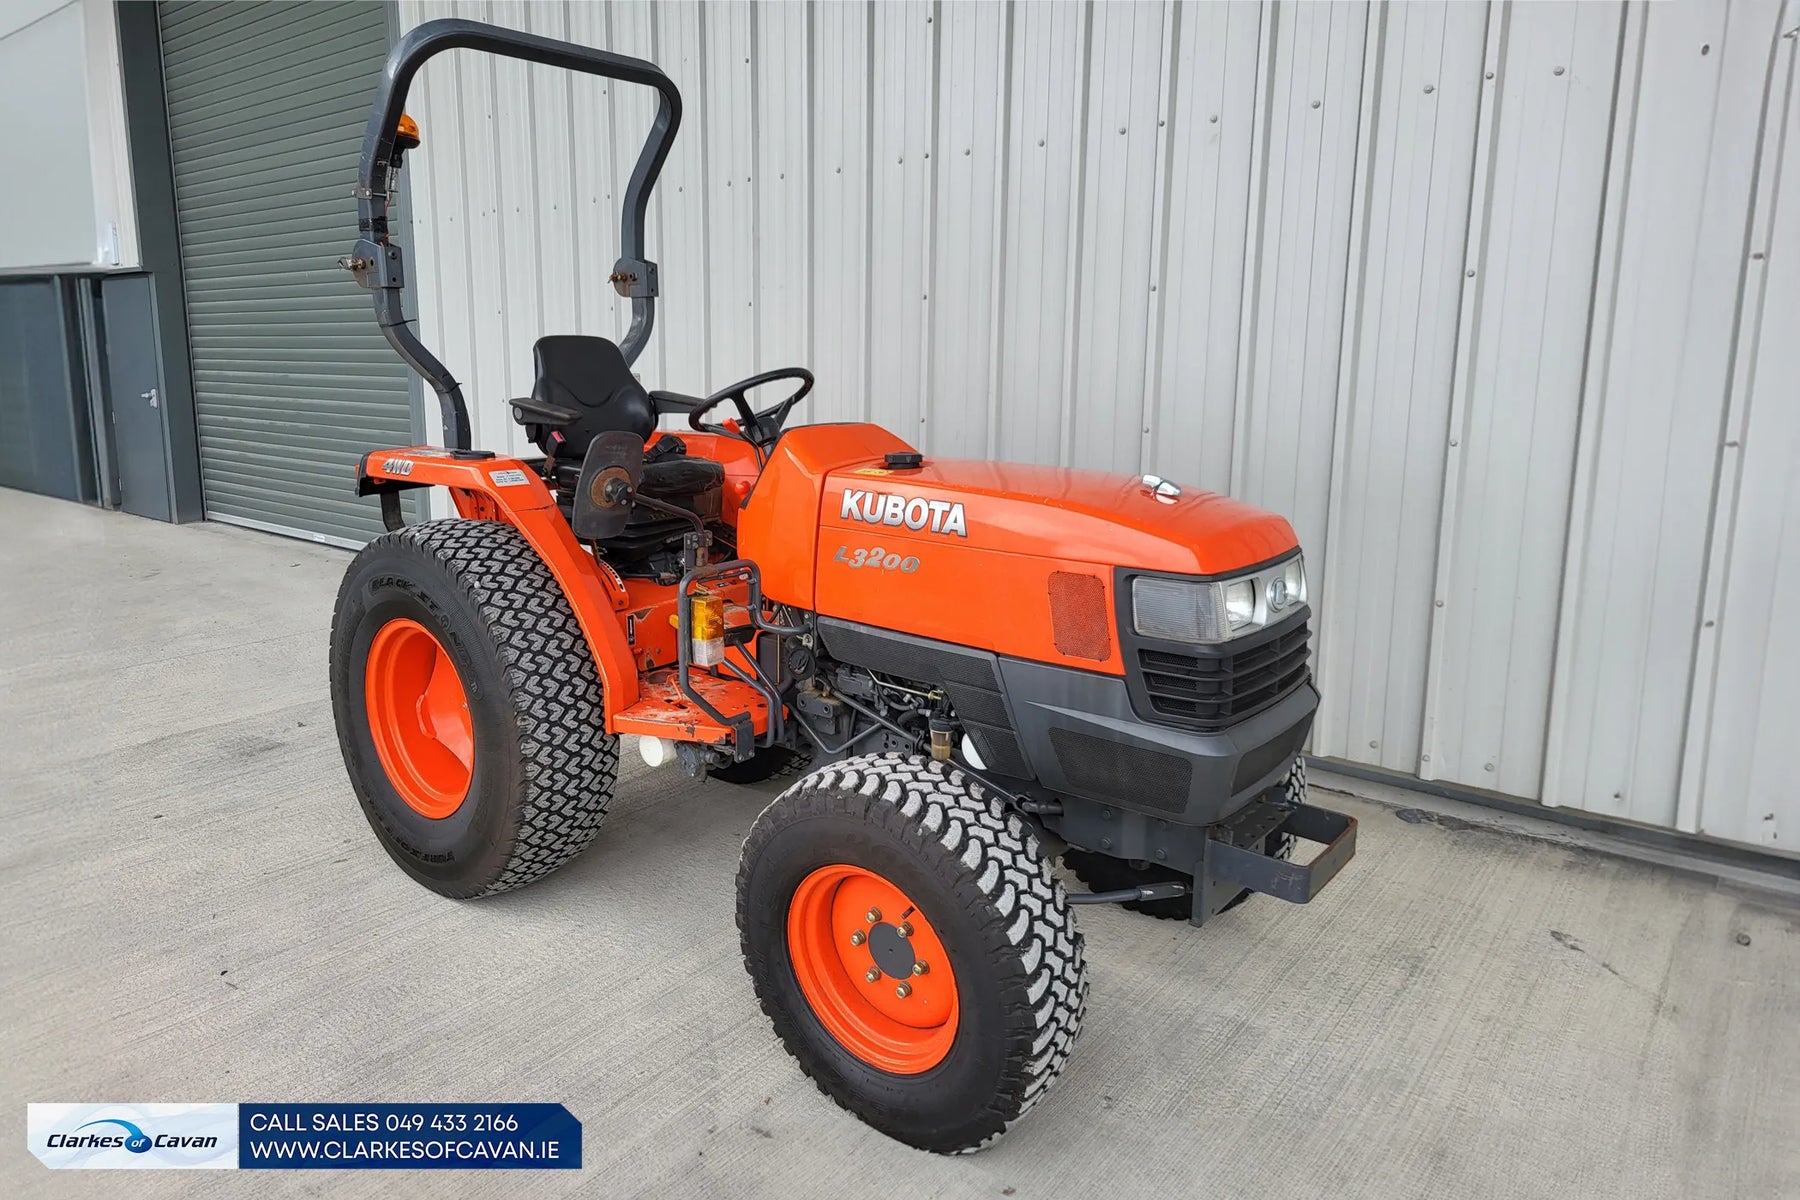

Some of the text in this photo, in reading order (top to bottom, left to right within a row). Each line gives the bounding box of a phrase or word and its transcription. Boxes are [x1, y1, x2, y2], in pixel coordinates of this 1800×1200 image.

[381, 458, 415, 476] 4WD
[840, 488, 968, 538] KUBOTA
[833, 546, 921, 573] L3200
